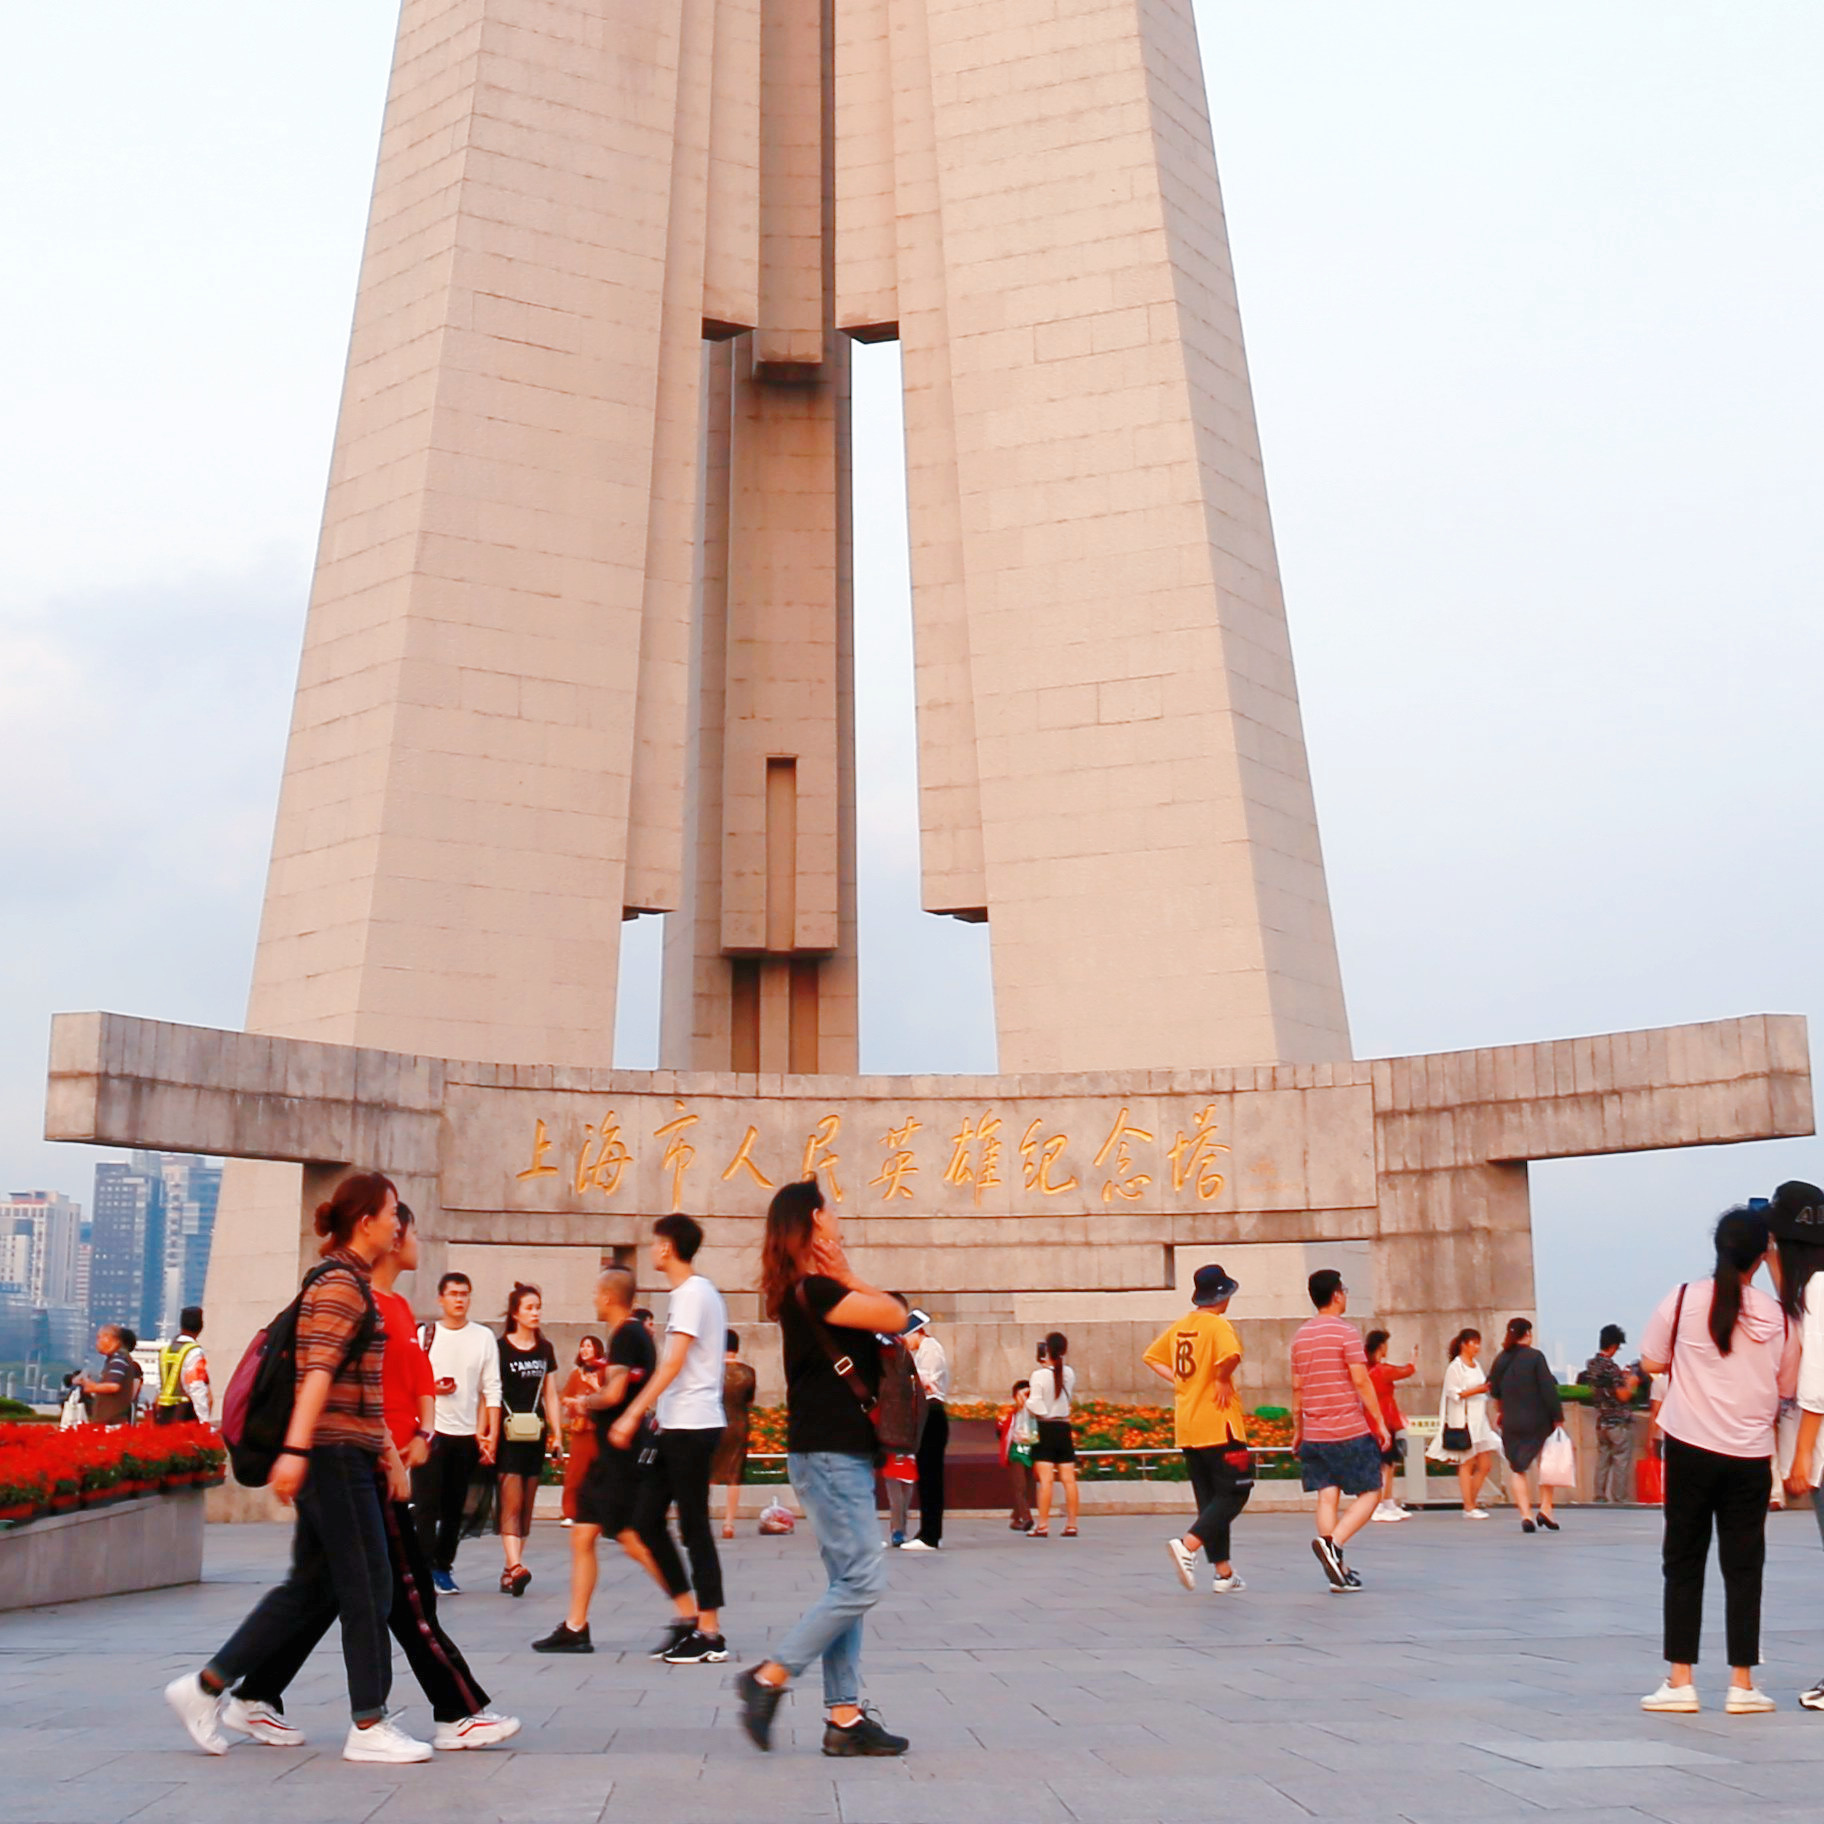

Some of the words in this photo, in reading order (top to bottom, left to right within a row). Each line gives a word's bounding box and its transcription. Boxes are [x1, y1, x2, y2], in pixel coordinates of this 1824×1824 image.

[516, 1100, 1233, 1212] 上海市人民英雄纪念塔
